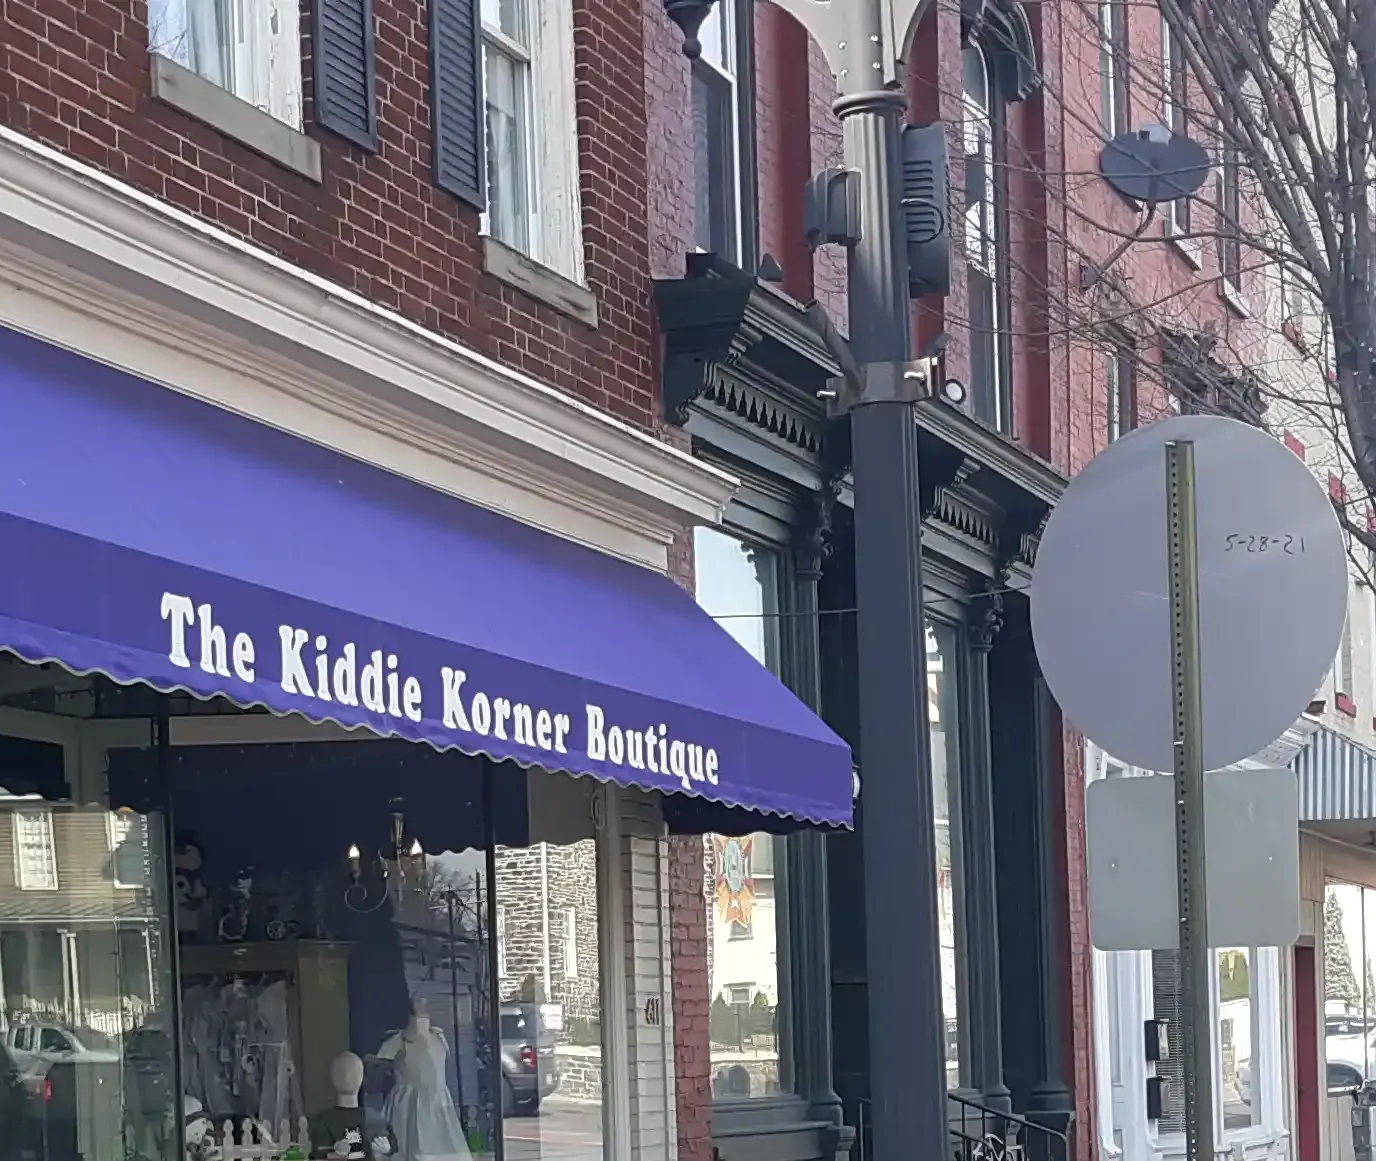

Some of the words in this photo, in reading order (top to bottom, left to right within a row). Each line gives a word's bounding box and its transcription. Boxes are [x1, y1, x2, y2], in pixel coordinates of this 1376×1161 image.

[1224, 533, 1305, 555] 5-28-21
[160, 591, 255, 683] The
[279, 624, 422, 722] Kiddie
[441, 666, 570, 754] Korner
[585, 703, 719, 790] Boutique
